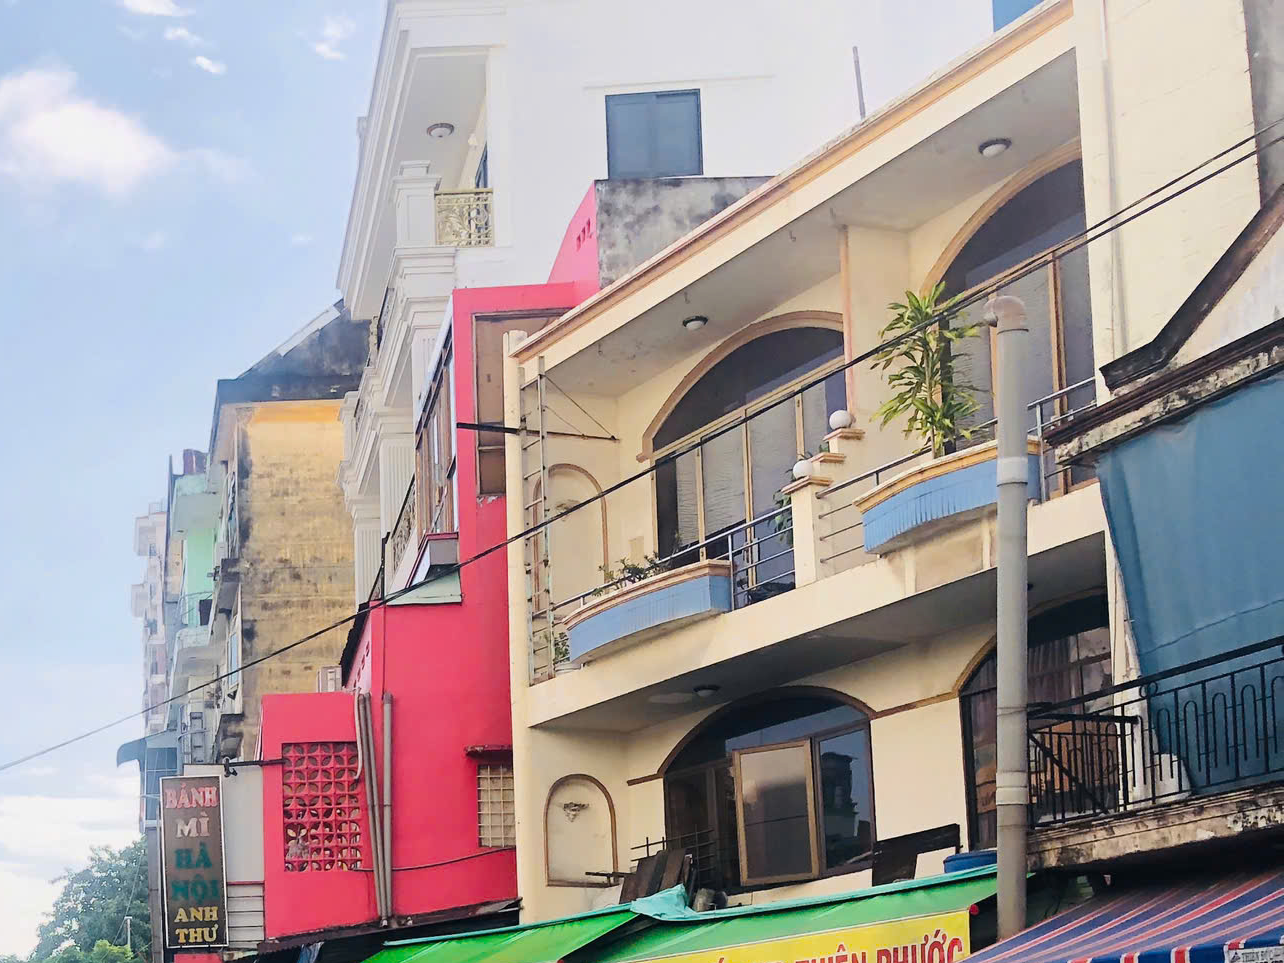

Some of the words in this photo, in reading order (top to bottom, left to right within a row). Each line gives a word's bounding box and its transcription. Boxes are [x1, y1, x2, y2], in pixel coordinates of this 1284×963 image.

[165, 783, 219, 809] BÁNH
[176, 811, 211, 838] MÌ
[175, 842, 212, 869] HÀ
[174, 907, 219, 923] ANH
[175, 924, 219, 944] THƯ
